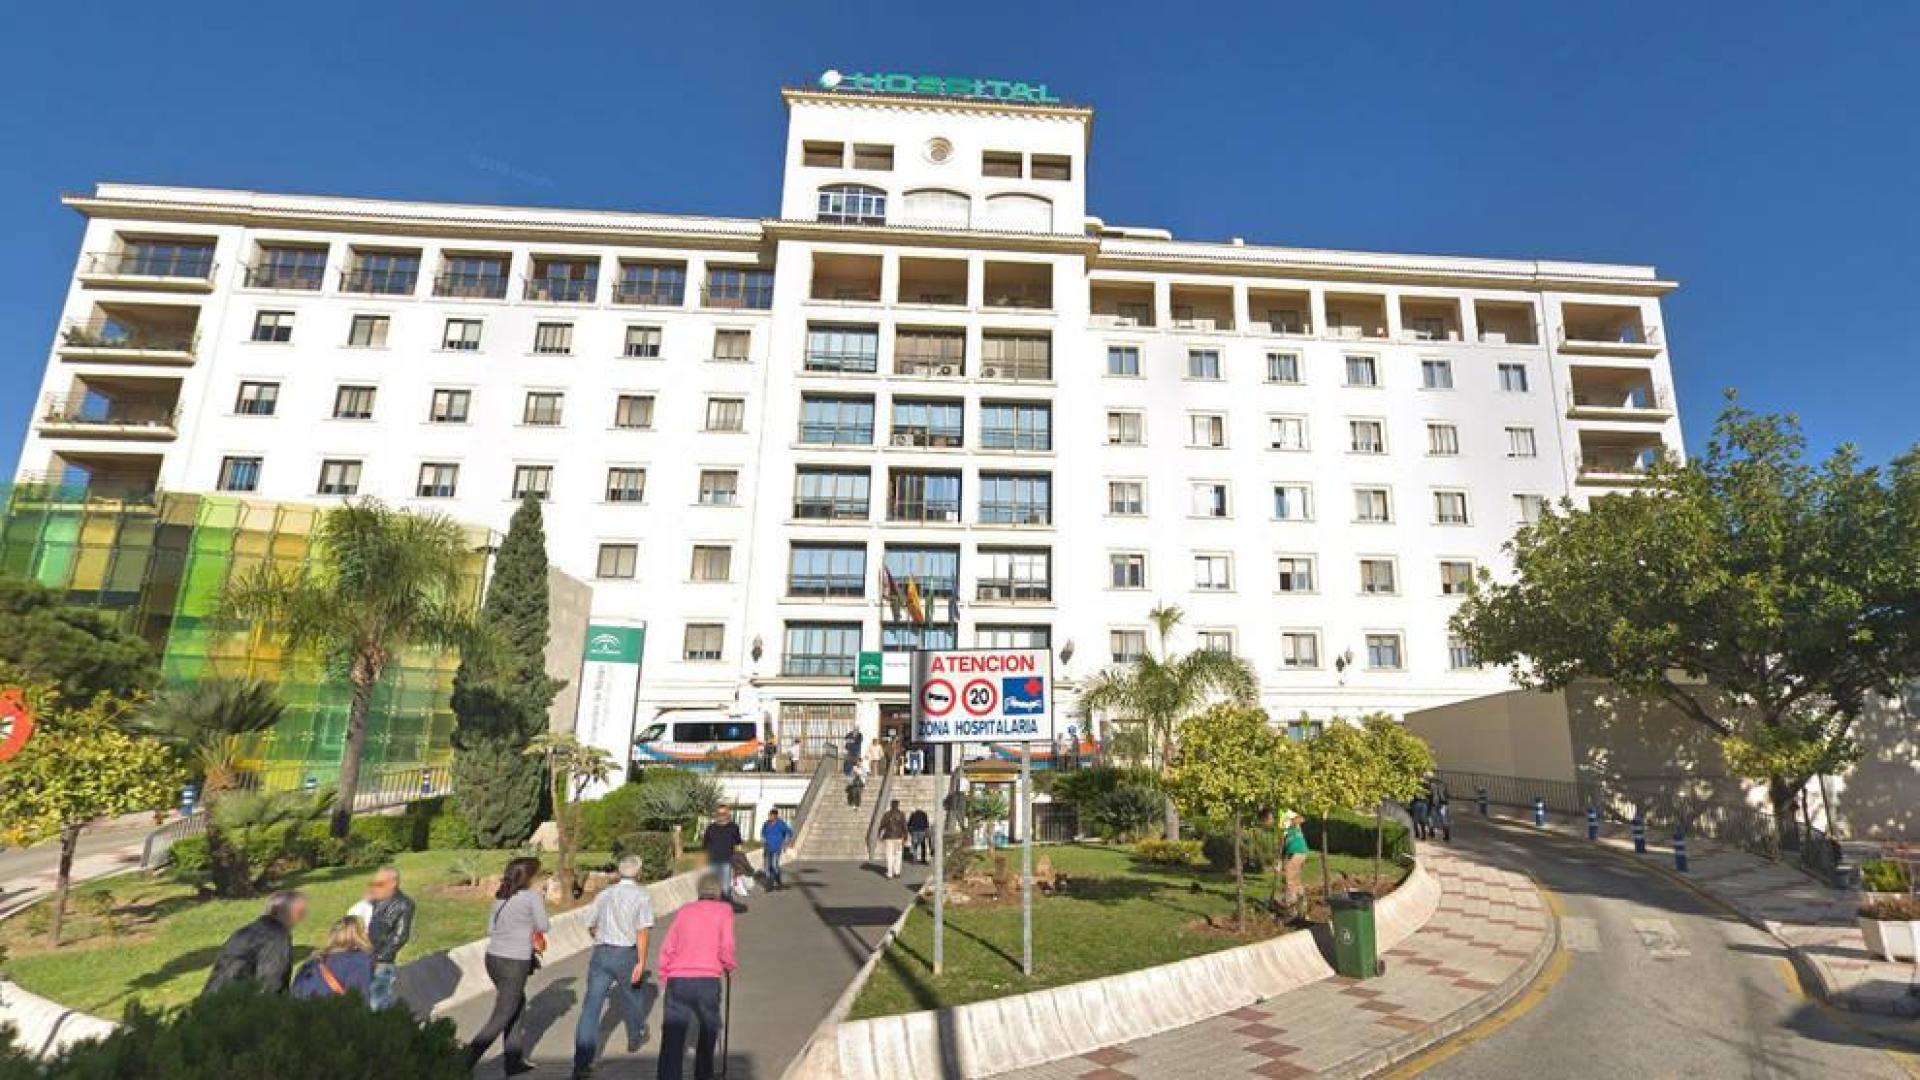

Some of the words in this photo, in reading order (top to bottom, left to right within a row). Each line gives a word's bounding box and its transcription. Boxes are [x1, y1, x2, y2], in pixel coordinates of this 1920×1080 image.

[854, 72, 1060, 102] HOSPITAL
[931, 655, 1035, 672] ATENCION
[970, 687, 989, 705] 20
[919, 719, 949, 735] ZONA
[955, 719, 1038, 735] HOSPITALARIA
